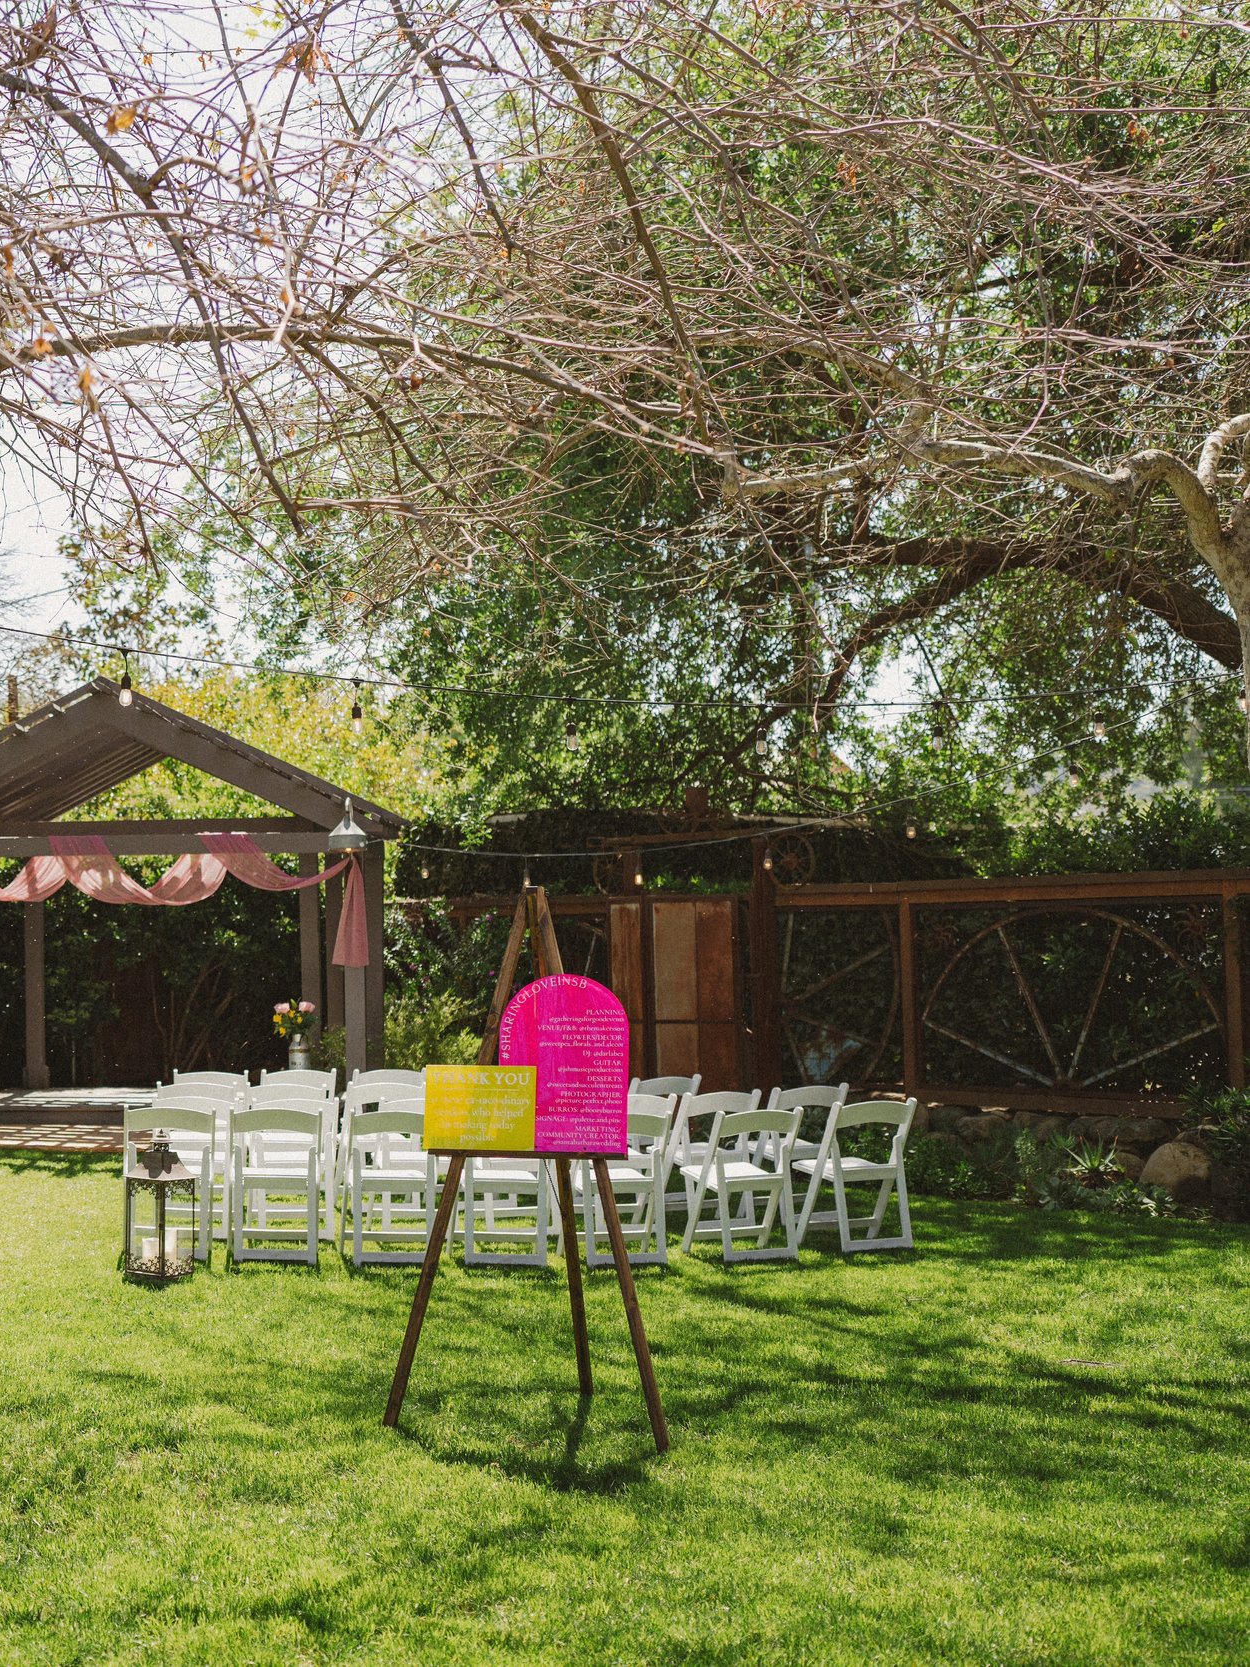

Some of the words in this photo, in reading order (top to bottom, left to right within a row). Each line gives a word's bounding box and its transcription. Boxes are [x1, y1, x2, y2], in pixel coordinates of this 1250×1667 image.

[501, 976, 587, 1059] #SHARINGLOVEINSB
[432, 1073, 490, 1085] THANK
[495, 1073, 530, 1085] YOU
[471, 1107, 491, 1117] who
[493, 1107, 524, 1119] helped
[453, 1119, 487, 1132] making
[459, 1131, 496, 1144] possible
